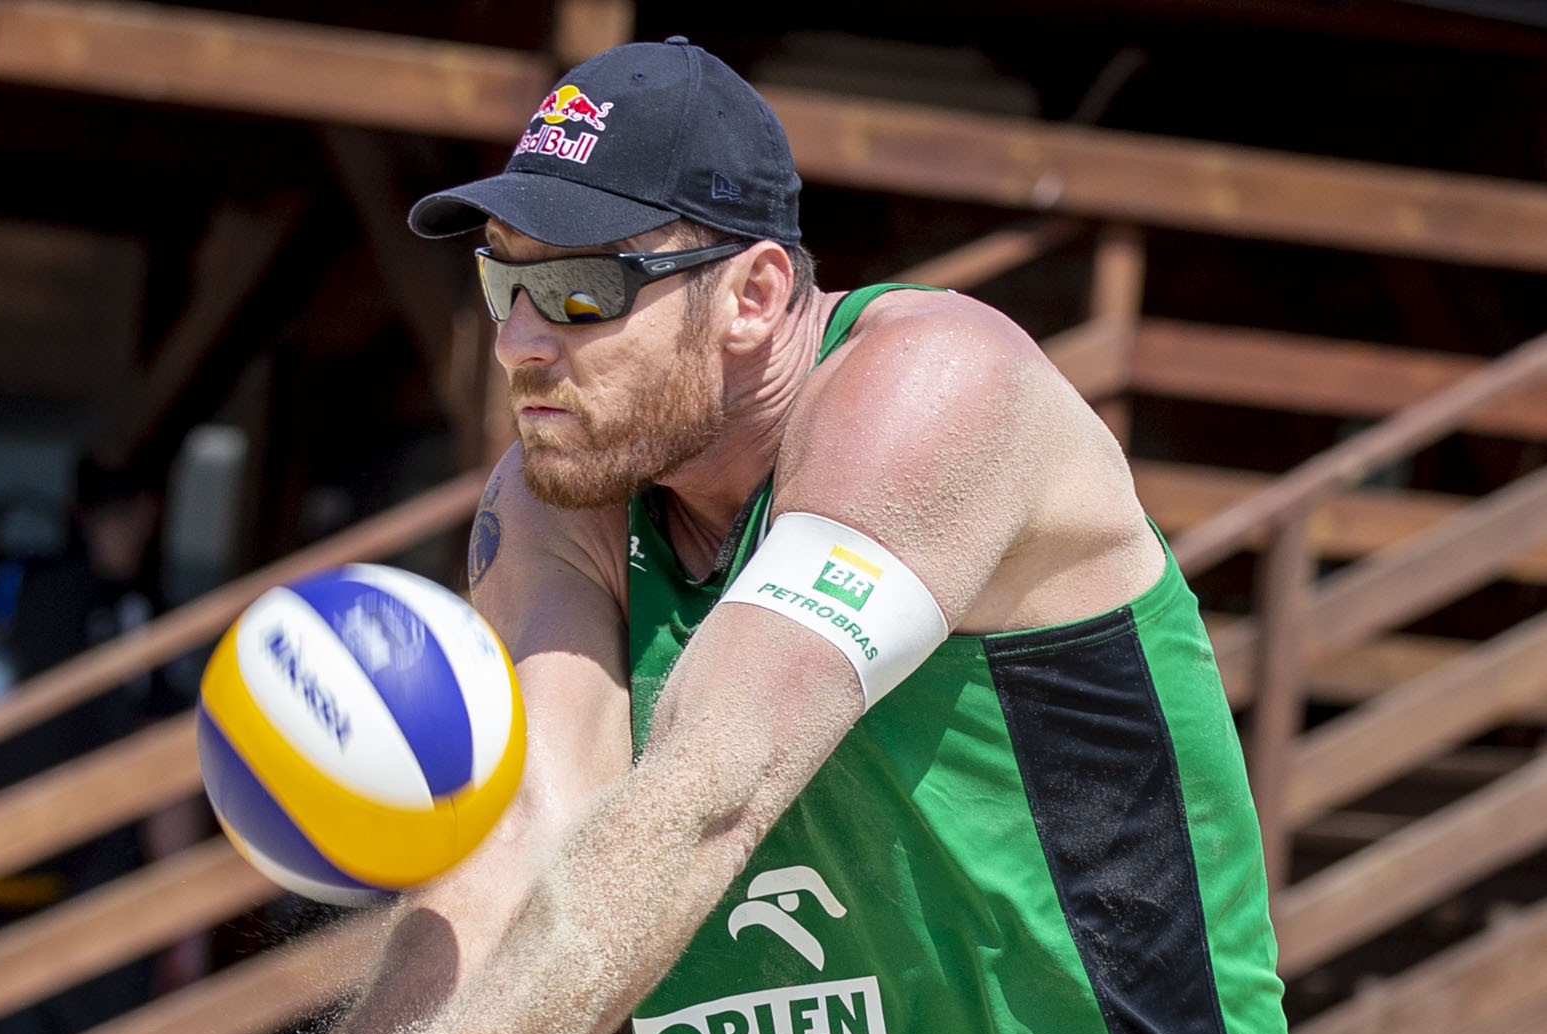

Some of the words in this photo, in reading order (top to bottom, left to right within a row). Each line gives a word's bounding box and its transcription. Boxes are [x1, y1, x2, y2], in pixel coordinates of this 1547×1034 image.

[539, 126, 599, 164] Bull
[822, 563, 873, 598] BR
[757, 582, 879, 661] PETROBRAS
